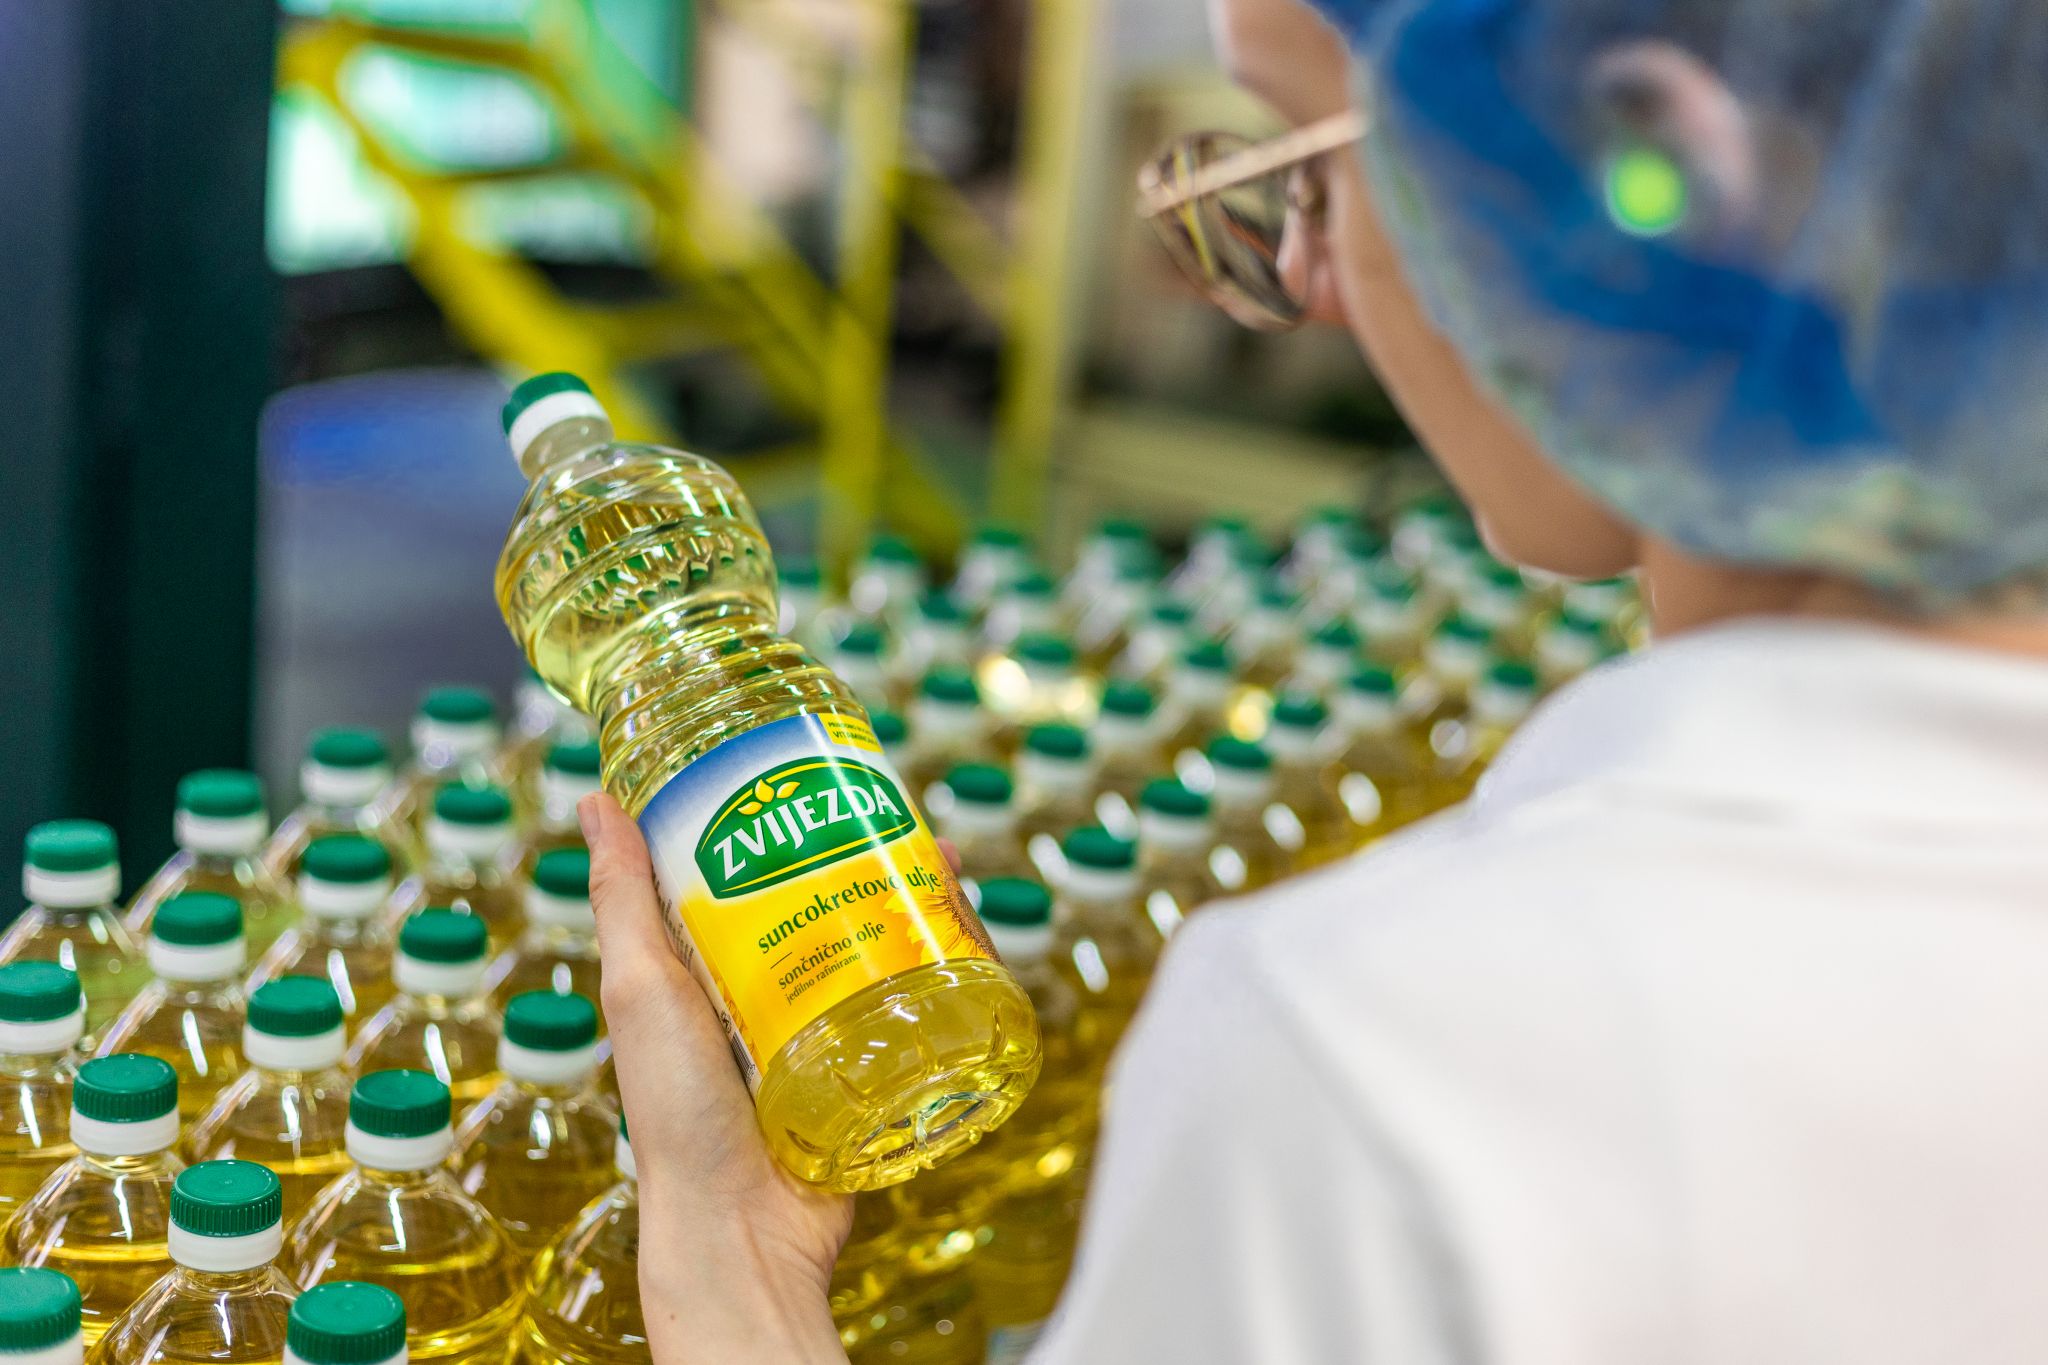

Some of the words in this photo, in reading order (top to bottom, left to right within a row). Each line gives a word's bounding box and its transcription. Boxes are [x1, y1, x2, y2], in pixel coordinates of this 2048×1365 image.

[713, 784, 902, 881] ZVIJEZDA
[758, 875, 903, 955] suncokretovo
[906, 866, 941, 893] ulje
[778, 936, 852, 990] sončnično
[856, 921, 887, 942] olje
[785, 978, 815, 1006] jedilno
[816, 951, 861, 982] rafinirano
